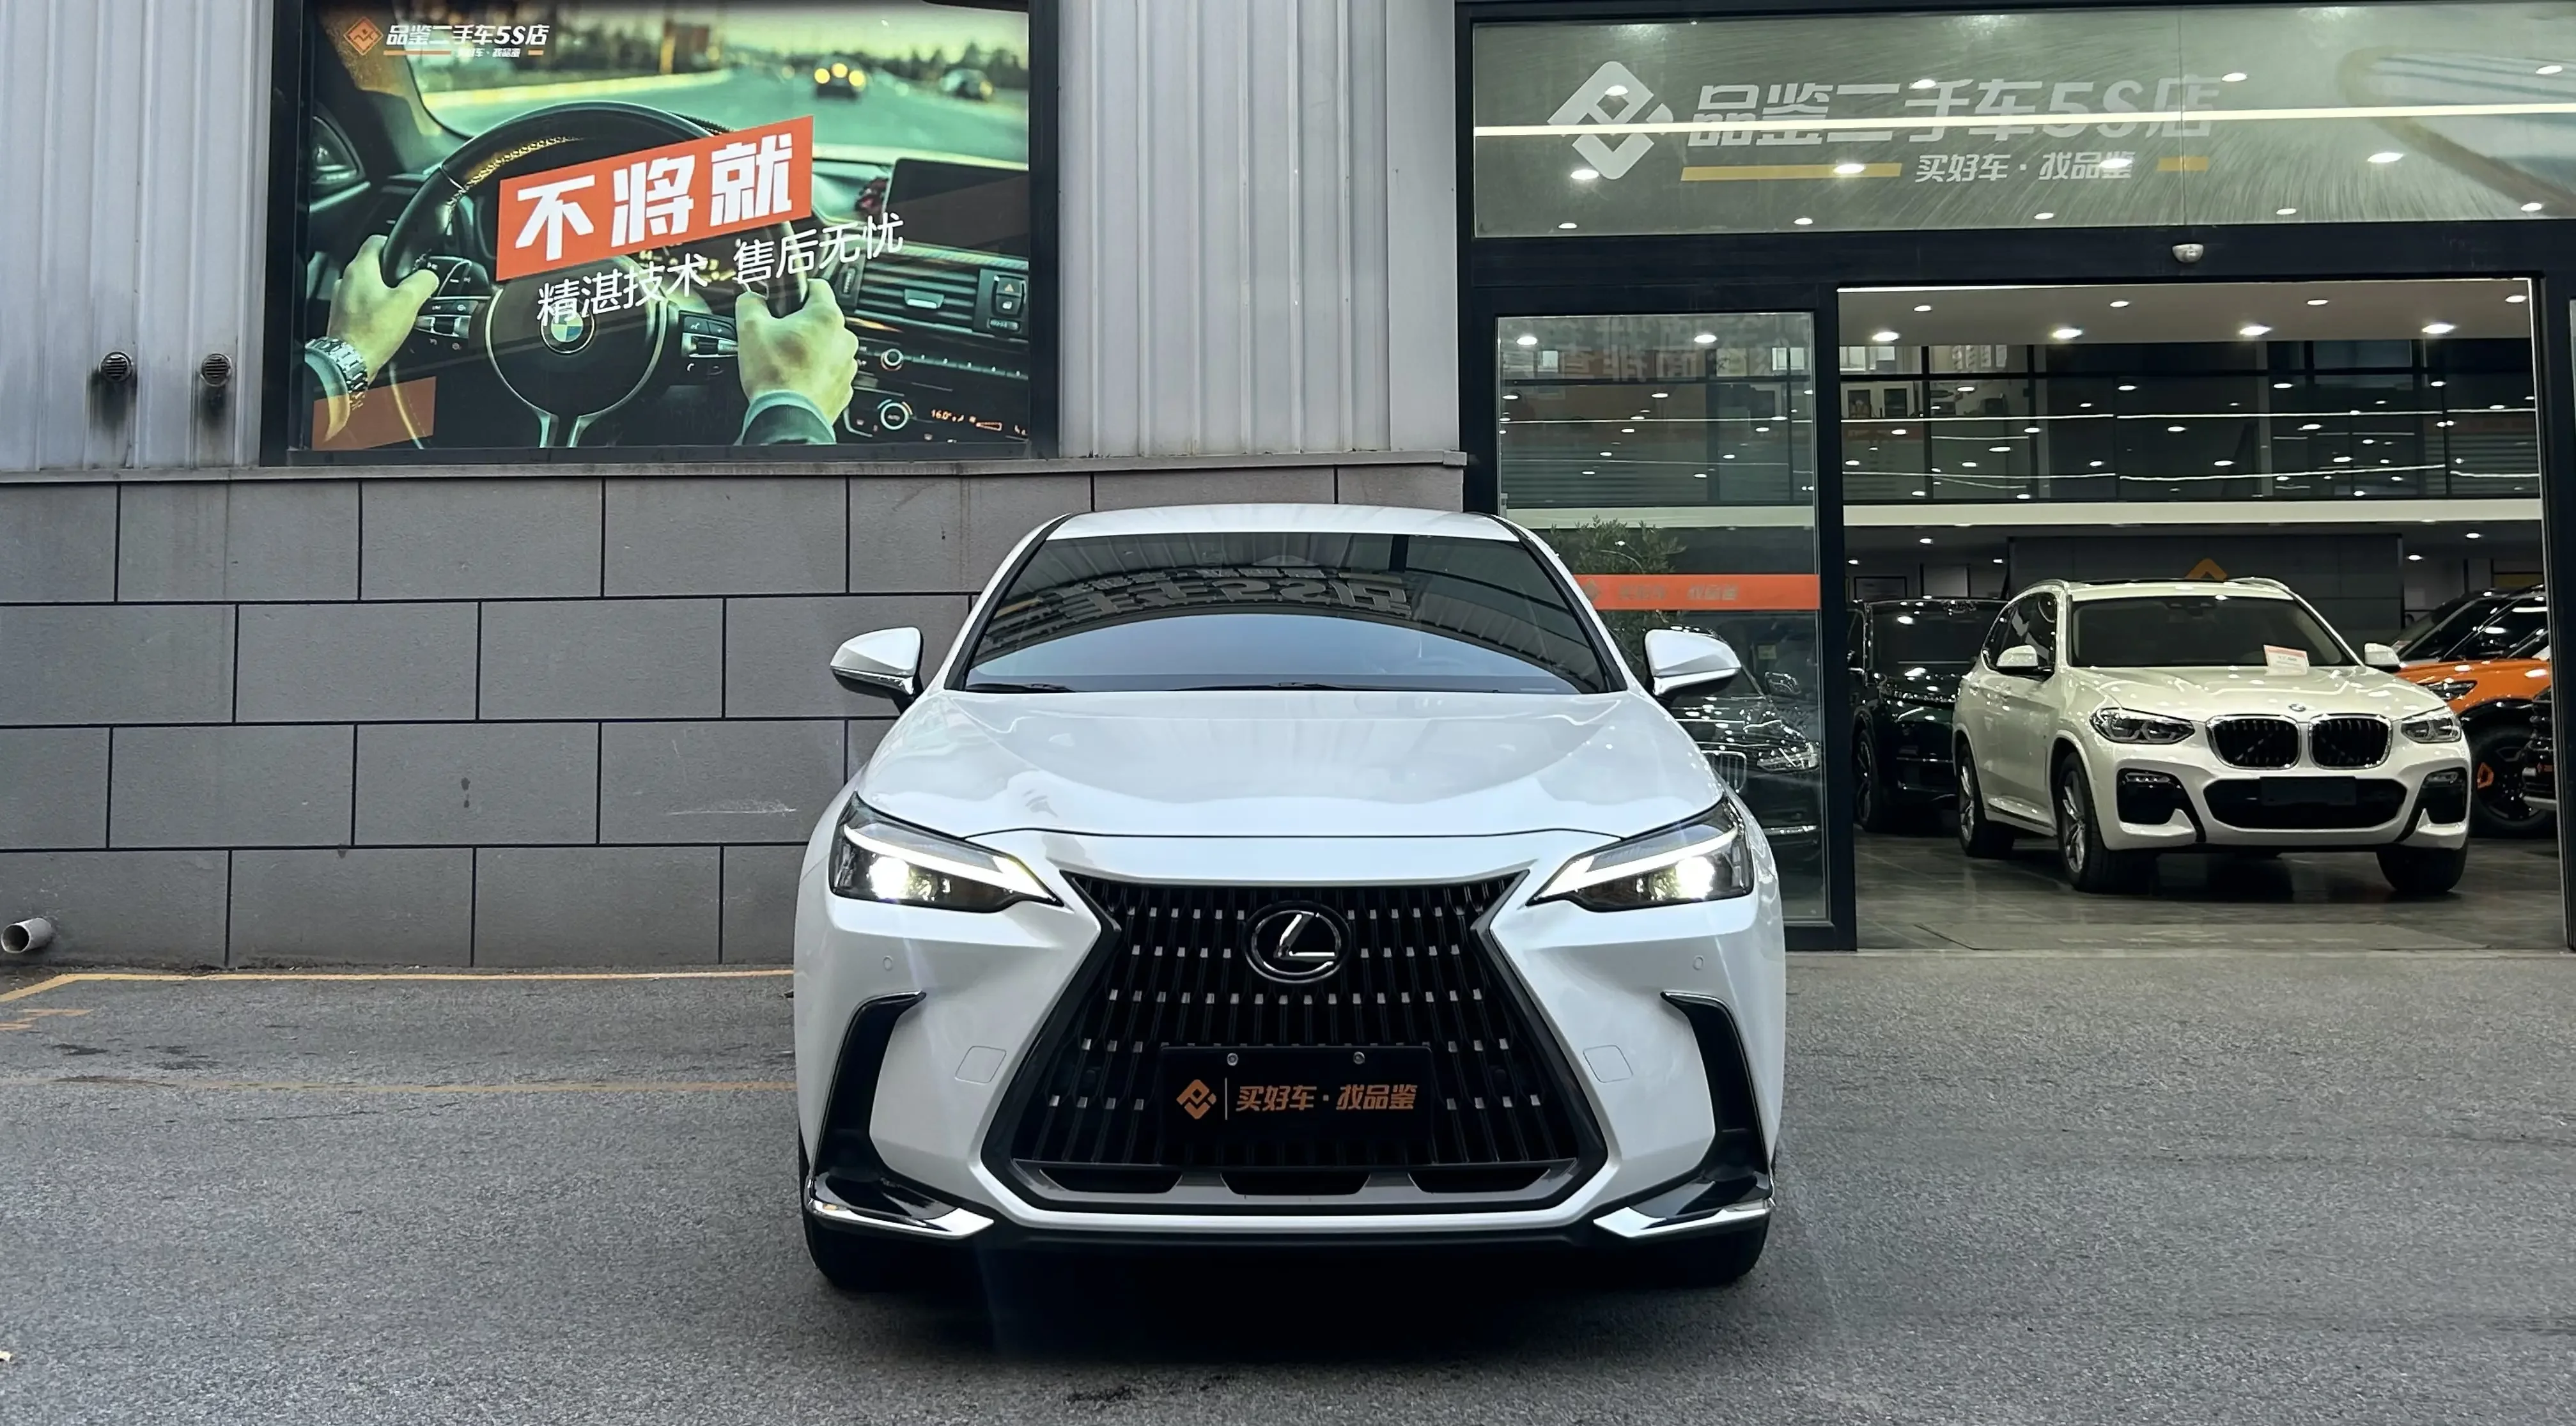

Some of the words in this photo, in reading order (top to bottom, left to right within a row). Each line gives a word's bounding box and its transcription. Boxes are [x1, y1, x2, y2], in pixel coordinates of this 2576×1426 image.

[386, 24, 550, 45] 品鉴二手车5S店
[1687, 74, 2221, 146] 品鉴二手车5S店
[515, 132, 793, 261] 不将就
[536, 252, 709, 329] 精湛技术
[733, 212, 904, 285] 售后无忧
